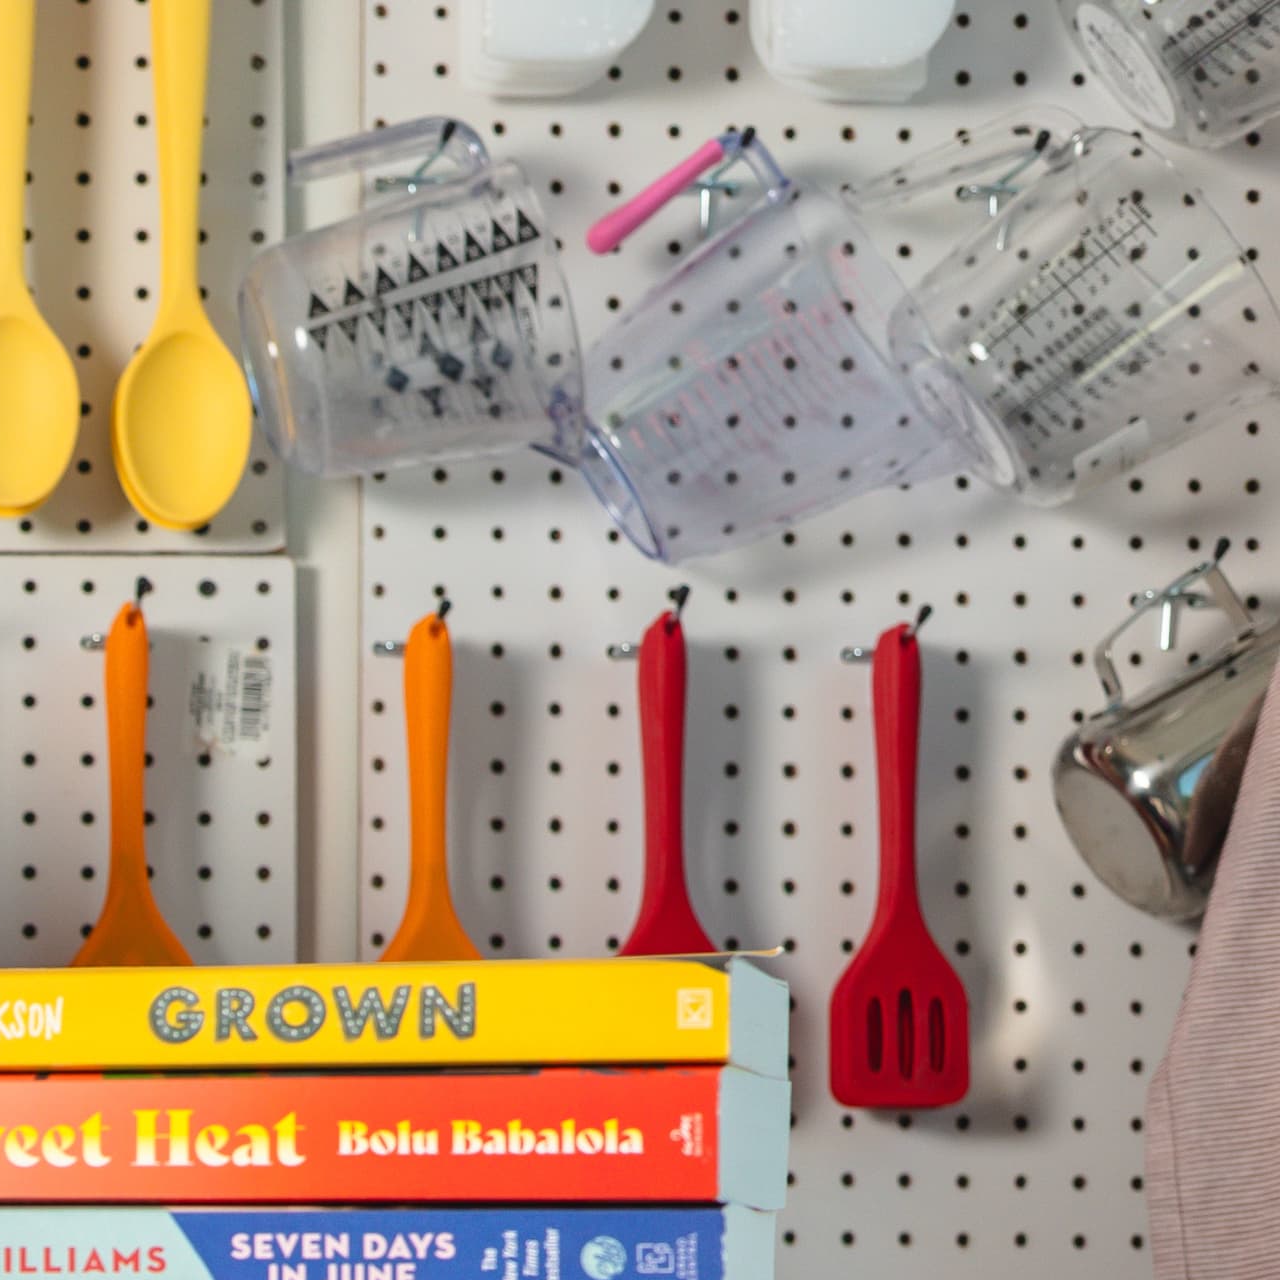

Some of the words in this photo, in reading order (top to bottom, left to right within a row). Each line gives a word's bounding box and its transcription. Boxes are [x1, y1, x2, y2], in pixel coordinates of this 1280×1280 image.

[148, 982, 477, 1044] GROWN
[130, 1108, 306, 1166] Heat
[337, 1119, 438, 1156] Bolu
[451, 1118, 644, 1155] Babalola
[230, 1232, 358, 1260] SEVEN
[362, 1232, 456, 1259] DAYS
